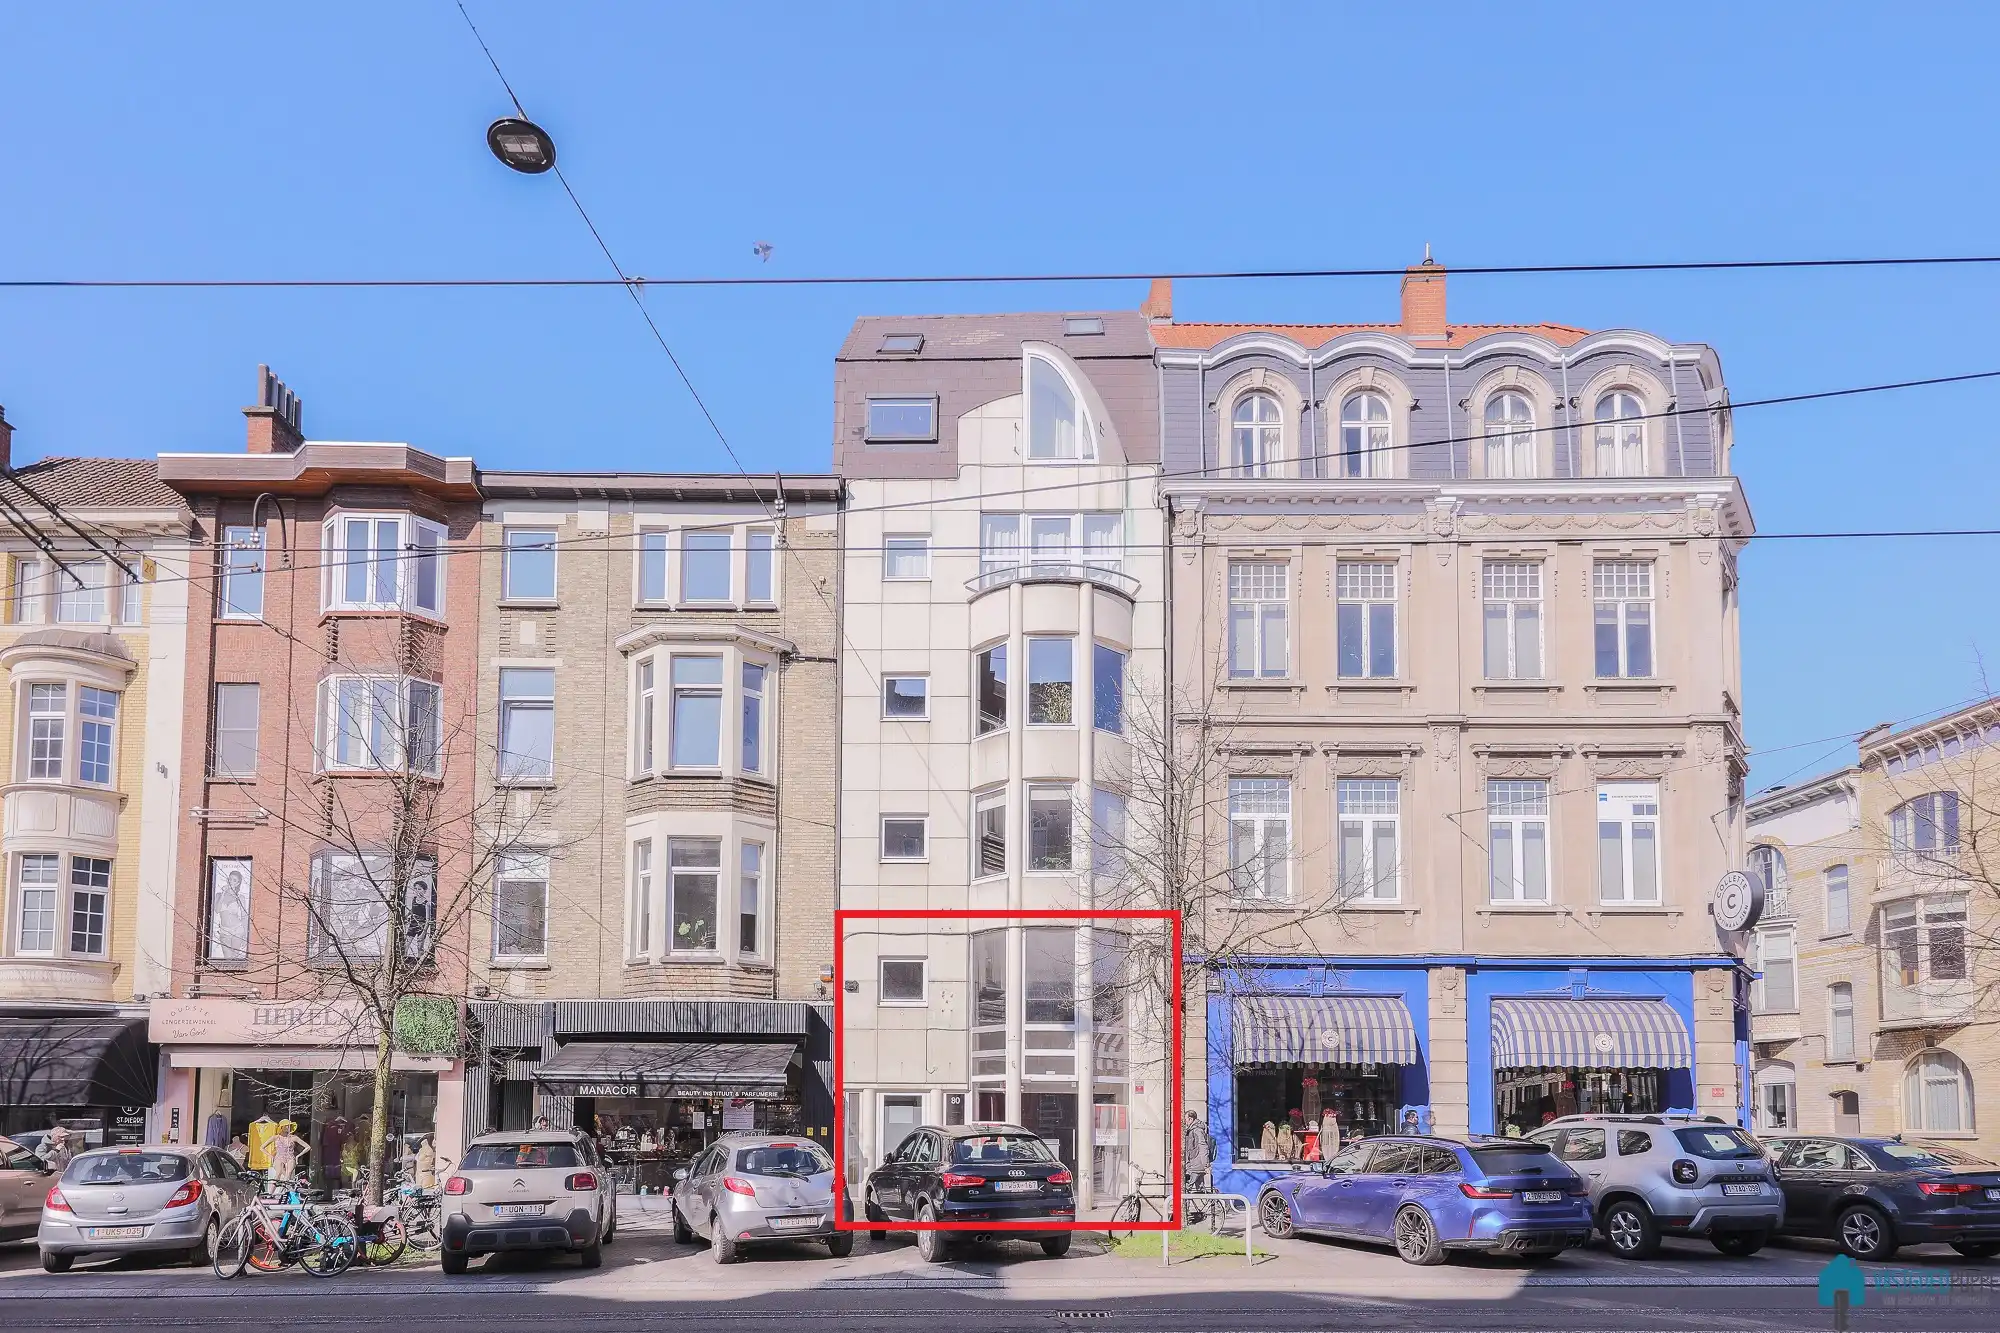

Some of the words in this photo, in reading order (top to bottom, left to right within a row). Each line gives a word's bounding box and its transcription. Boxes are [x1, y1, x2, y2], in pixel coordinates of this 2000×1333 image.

[144, 562, 155, 577] 20
[1717, 875, 1748, 898] COLLETTE
[1727, 893, 1737, 909] C
[170, 1005, 210, 1017] OUDSTE
[579, 1086, 637, 1095] MANACOR
[950, 1096, 961, 1105] 80
[96, 1227, 142, 1236] 1-UKS-035
